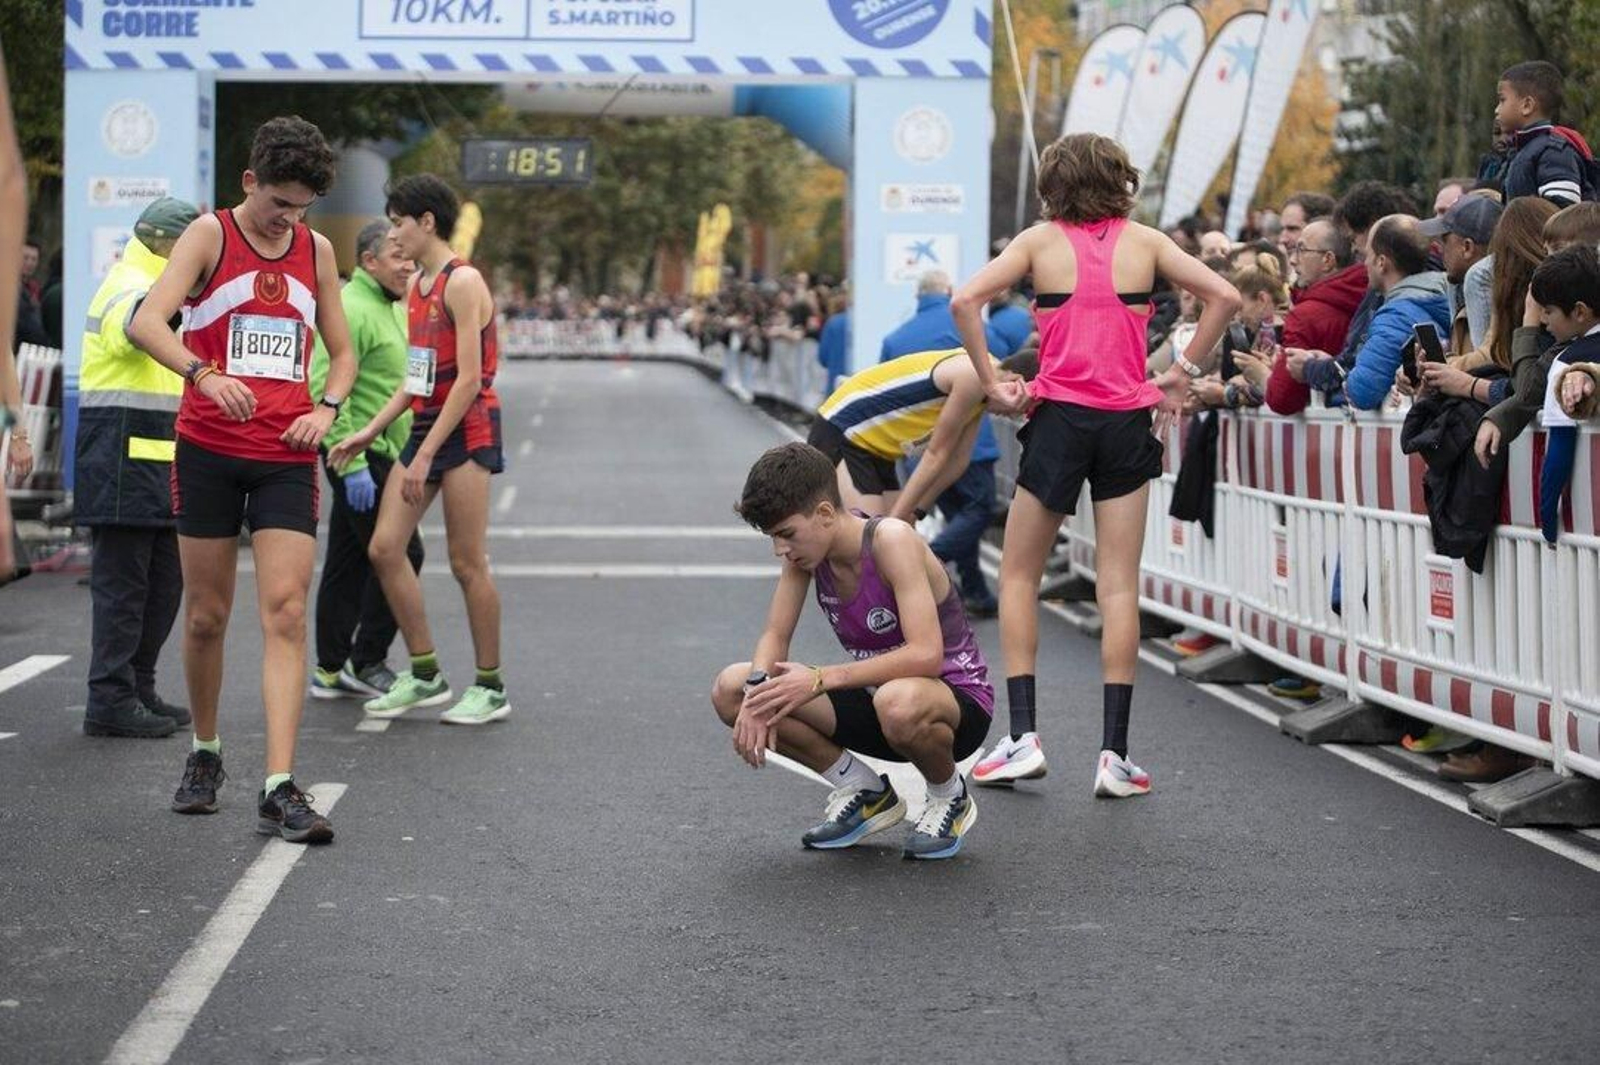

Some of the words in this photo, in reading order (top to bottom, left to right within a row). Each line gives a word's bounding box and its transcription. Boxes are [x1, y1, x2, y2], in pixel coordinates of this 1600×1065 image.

[102, 11, 199, 37] CORRE
[390, 0, 502, 24] 10KM.
[548, 5, 676, 26] S.MARTIÑO
[247, 332, 293, 358] 8022
